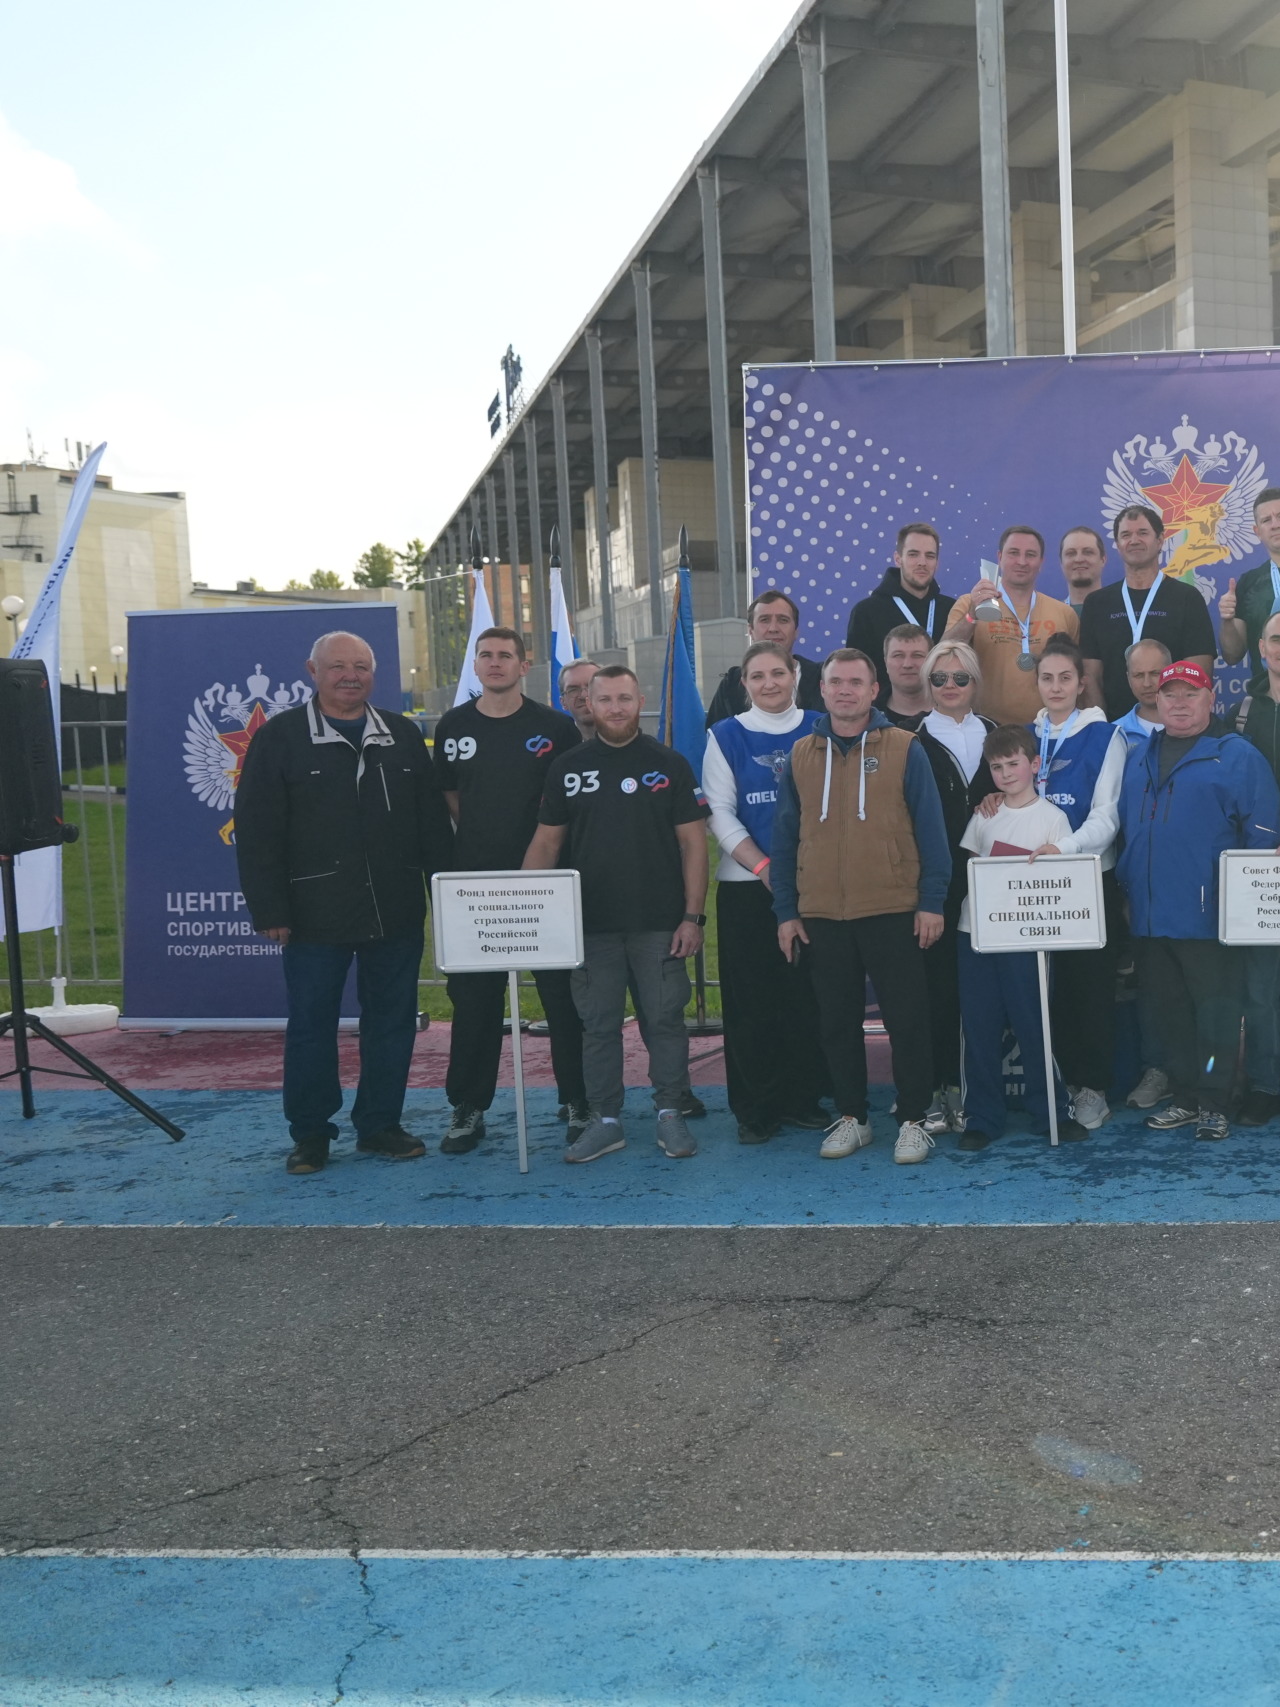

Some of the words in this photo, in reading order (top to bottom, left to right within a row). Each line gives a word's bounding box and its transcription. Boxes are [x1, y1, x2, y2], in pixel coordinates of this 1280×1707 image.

[443, 736, 478, 762] 99
[564, 770, 601, 797] 93
[1242, 866, 1270, 875] Совет
[1008, 877, 1072, 890] ГЛАВНЫЙ
[456, 889, 485, 898] Фонд
[488, 888, 554, 897] пенсионного
[1018, 895, 1062, 907] ЦЕНТР
[468, 904, 475, 912] и
[478, 903, 544, 912] социального
[988, 908, 1091, 922] СПЕЦИАЛЬНОЙ
[474, 916, 540, 927] страхования
[167, 921, 256, 936] СПОРТИВ
[478, 929, 538, 939] Российской
[1019, 926, 1062, 937] СВЯЗИ
[480, 944, 539, 954] Федерации
